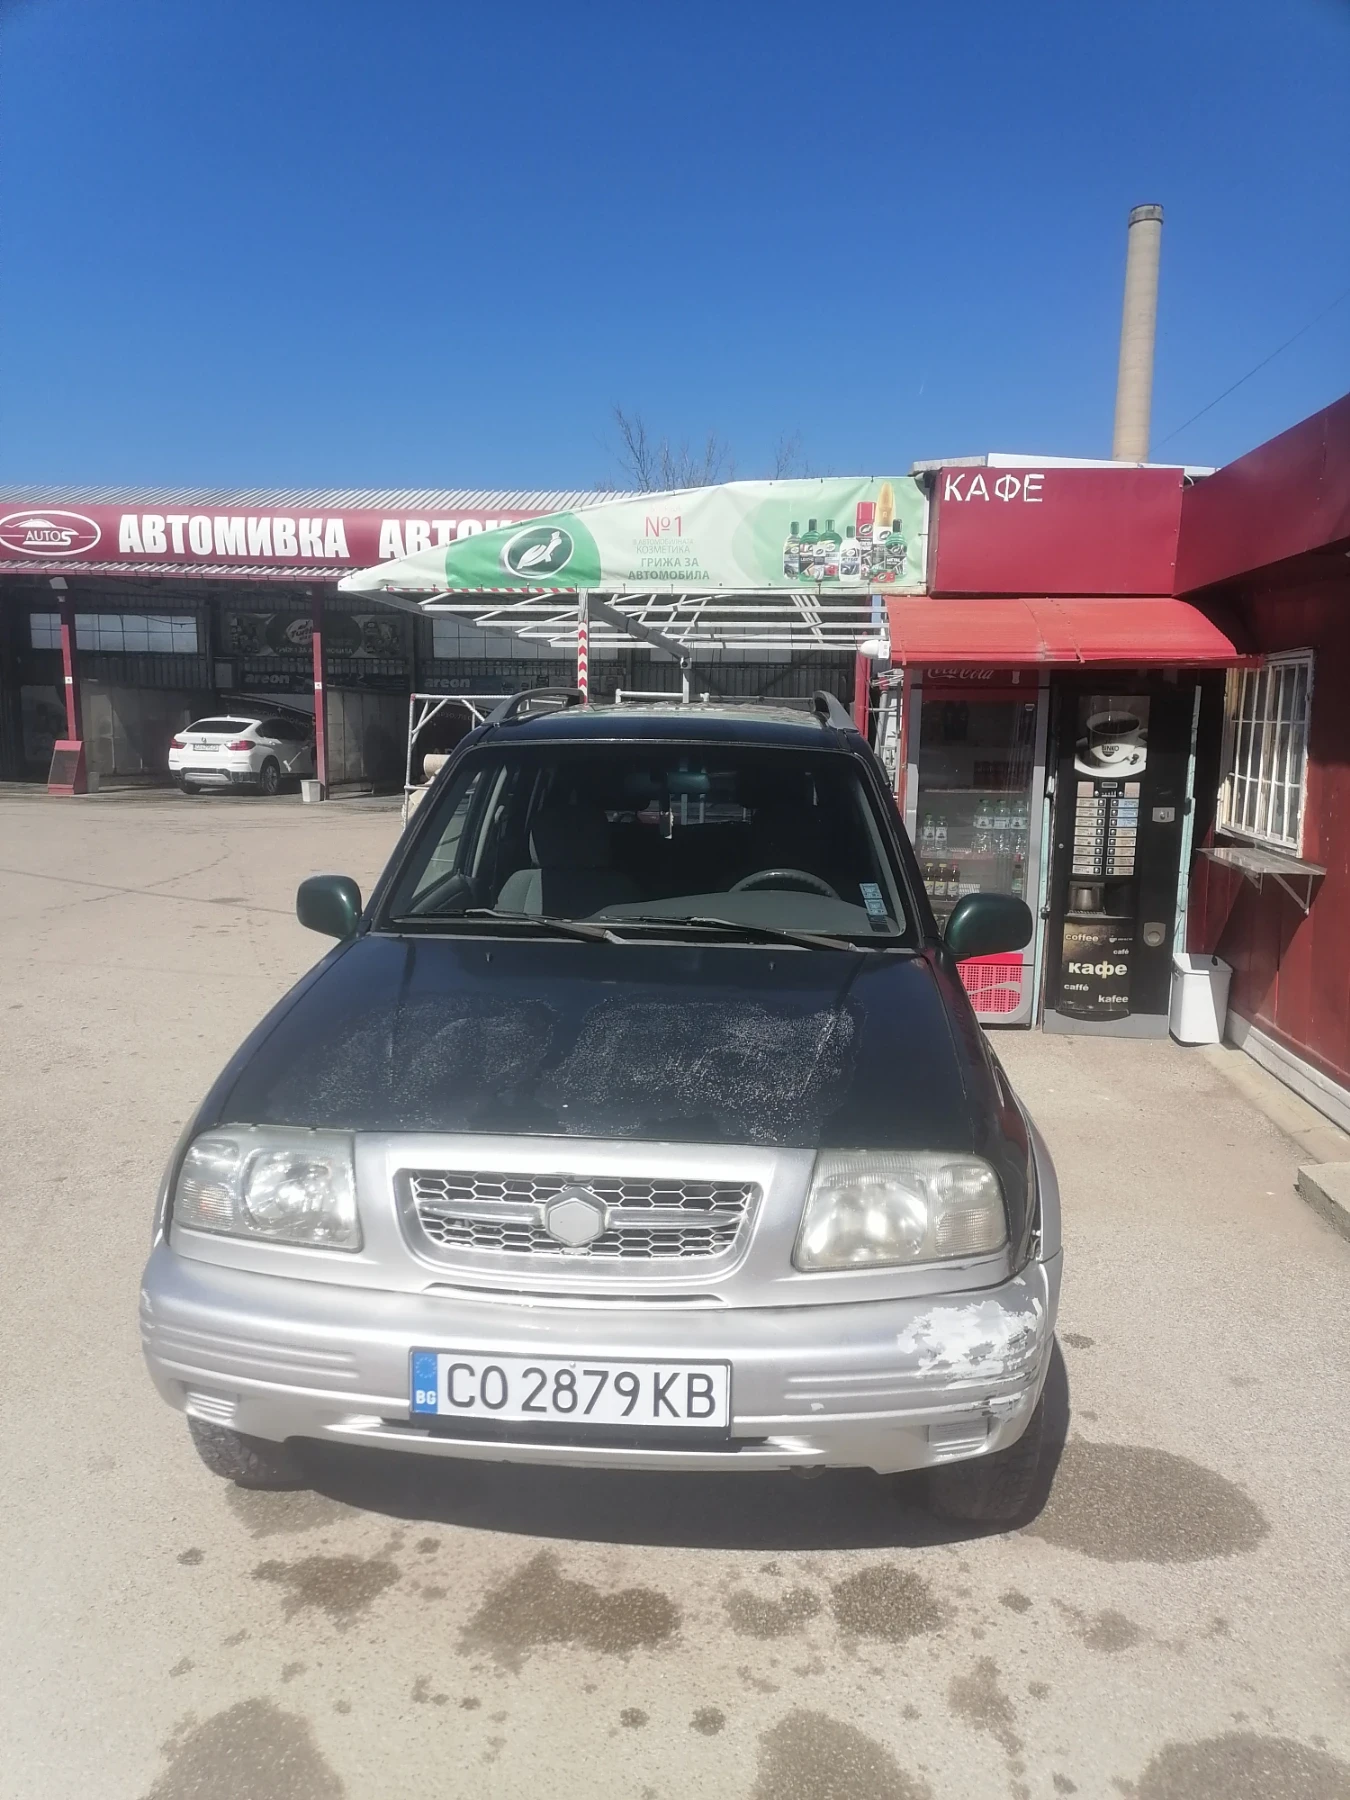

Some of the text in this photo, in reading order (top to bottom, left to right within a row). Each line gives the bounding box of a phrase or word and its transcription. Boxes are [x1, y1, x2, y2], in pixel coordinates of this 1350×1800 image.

[944, 474, 1045, 502] КАФЕ
[119, 514, 350, 558] АВТОМИВКА
[636, 545, 691, 554] КОЗМЕТИКА
[641, 557, 699, 567] ГРИЖА ЗА
[627, 570, 710, 580] АВТОМОБИЛА
[244, 673, 290, 684] areon
[424, 678, 471, 688] areon
[1065, 933, 1099, 942] coffee
[1068, 960, 1128, 979] кафе
[1098, 994, 1129, 1003] kafee
[521, 1367, 641, 1417] 2879
[416, 1389, 437, 1406] BG
